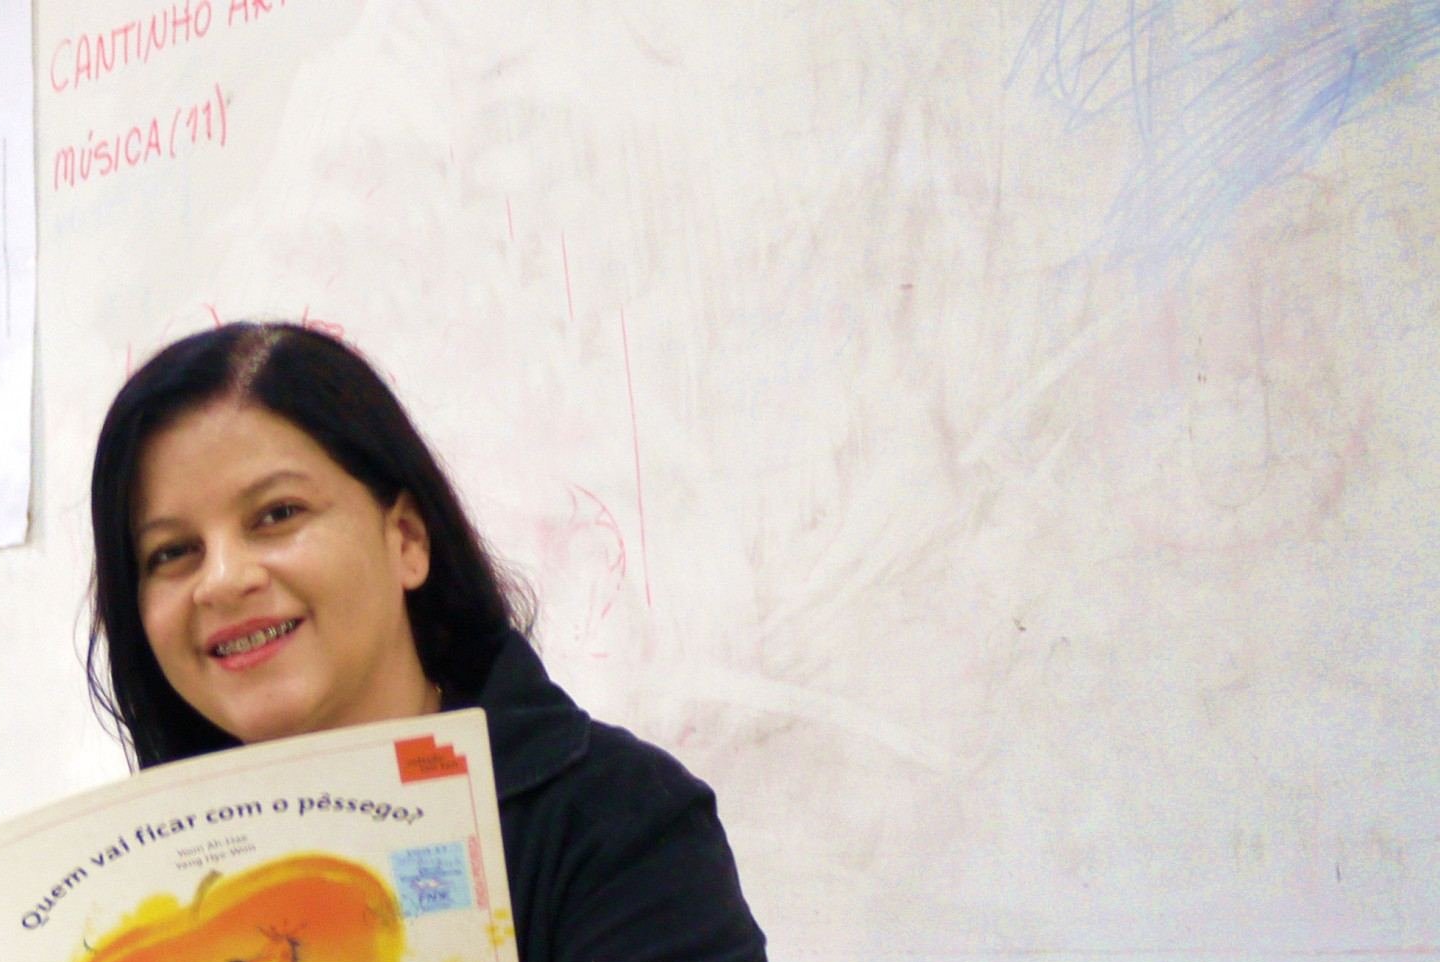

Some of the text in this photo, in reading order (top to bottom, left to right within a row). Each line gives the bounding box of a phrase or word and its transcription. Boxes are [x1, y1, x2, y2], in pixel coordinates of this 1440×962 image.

[51, 0, 212, 92] CANTINHO
[21, 792, 424, 931] Quem vai ficar com o pêssego?
